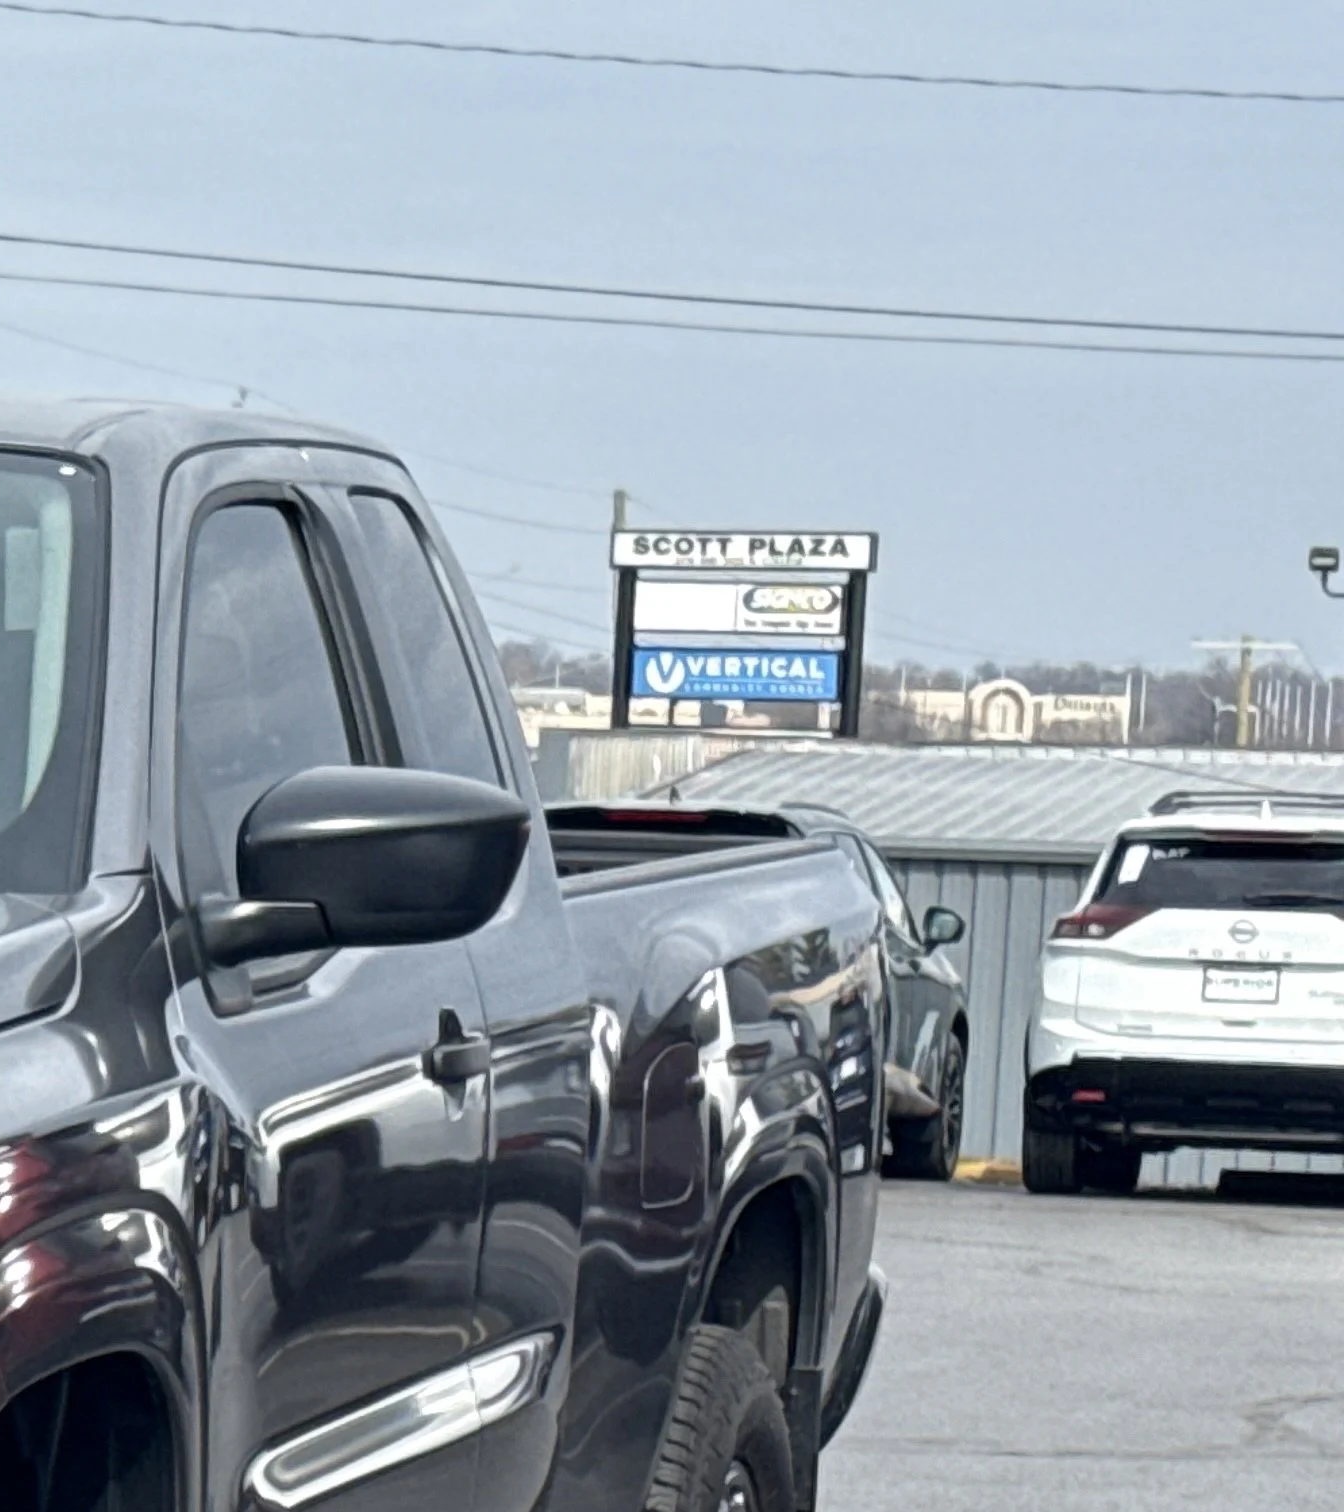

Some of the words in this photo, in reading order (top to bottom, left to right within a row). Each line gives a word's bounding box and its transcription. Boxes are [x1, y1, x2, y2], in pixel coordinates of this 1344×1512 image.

[632, 536, 732, 556] SCOTT
[748, 537, 850, 558] PLAZA
[686, 656, 825, 679] VERTICAL
